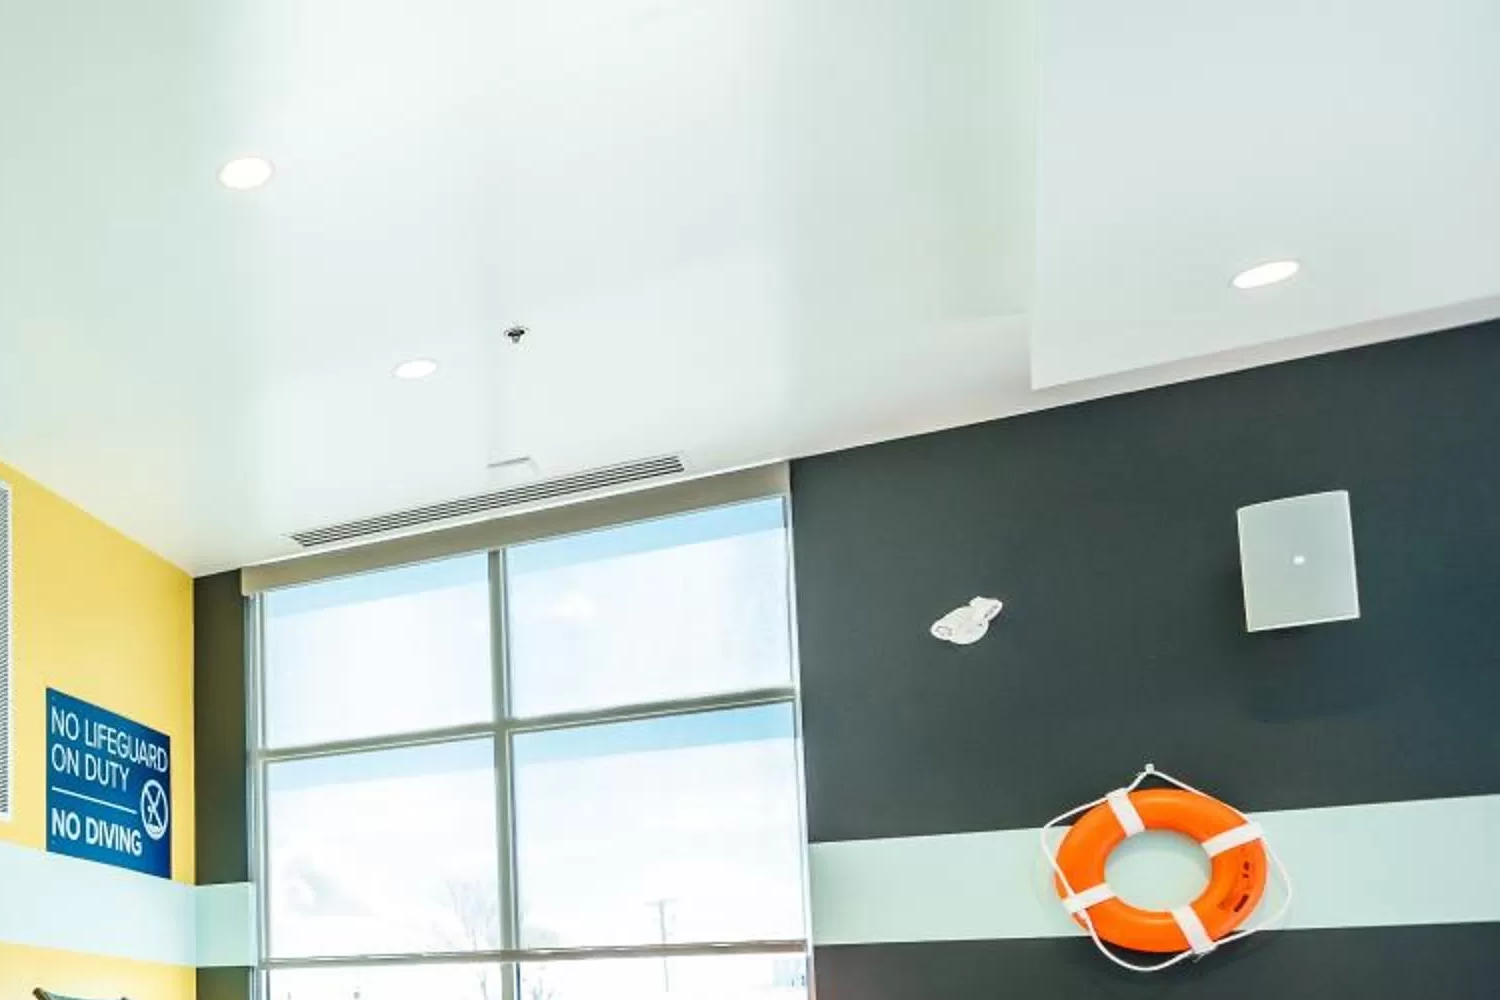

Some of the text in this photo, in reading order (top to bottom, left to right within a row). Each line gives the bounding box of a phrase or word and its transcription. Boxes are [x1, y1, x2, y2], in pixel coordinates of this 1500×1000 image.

[51, 706, 169, 773] NO LIFEGUARD
[51, 743, 130, 792] ON DUTY
[52, 807, 143, 856] NO DIVING
